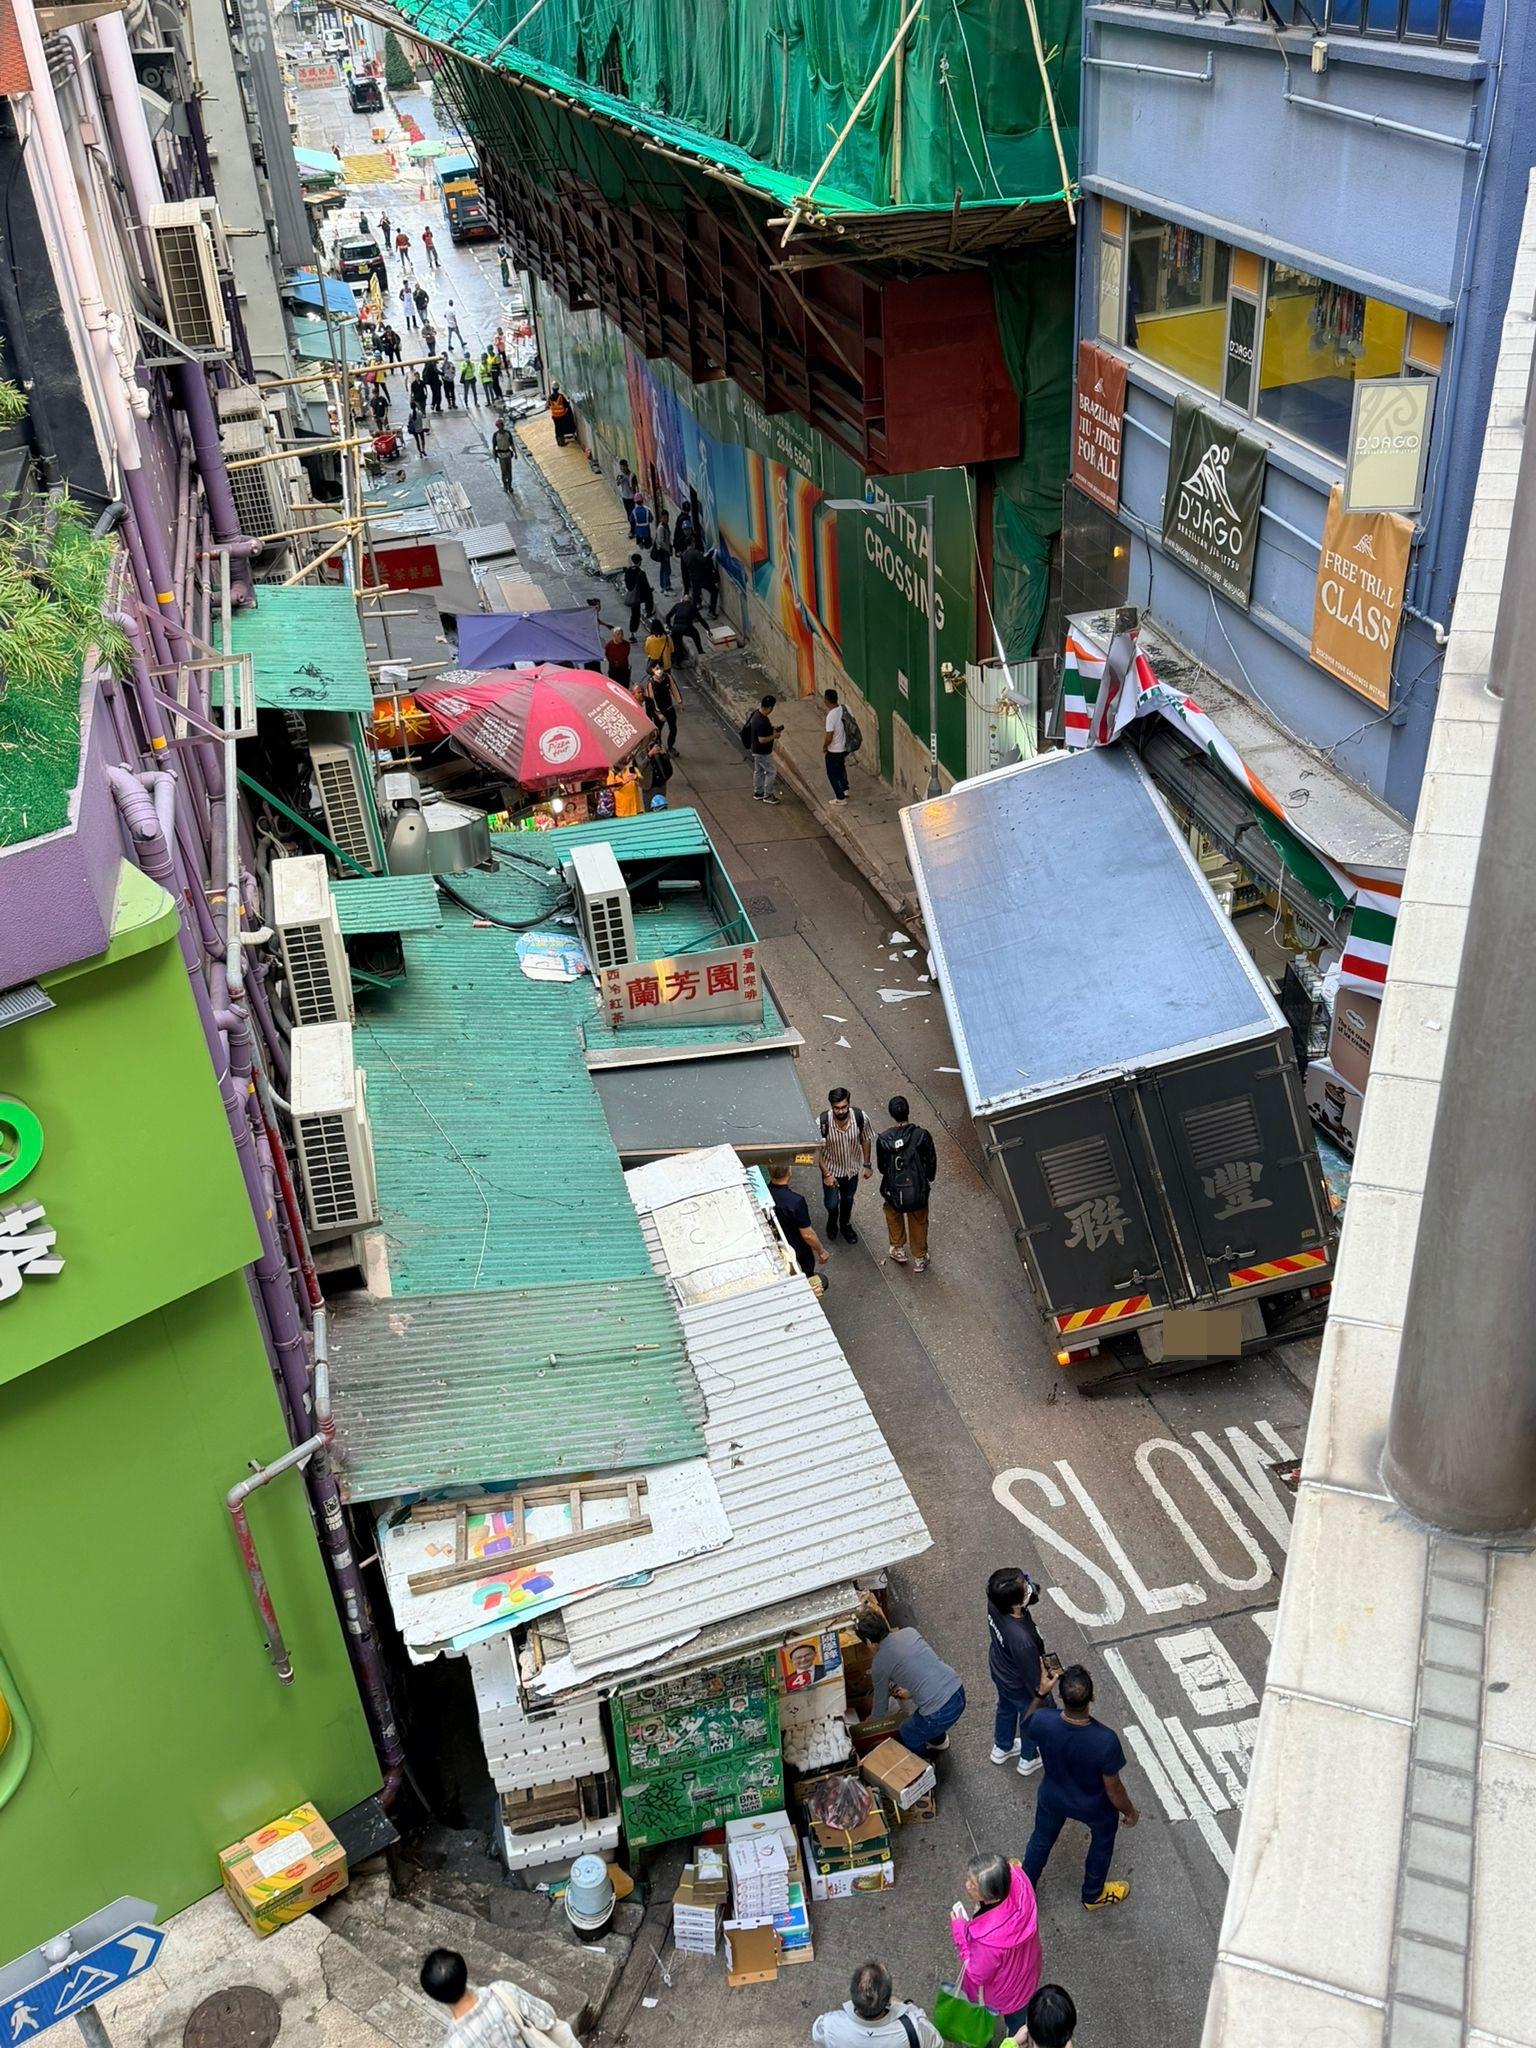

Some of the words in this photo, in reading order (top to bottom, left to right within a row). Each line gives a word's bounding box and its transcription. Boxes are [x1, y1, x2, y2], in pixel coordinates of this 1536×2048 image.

[1079, 393, 1121, 433] BRAZILIAN
[1077, 436, 1097, 469] FOR
[1096, 454, 1118, 481] ALL
[1356, 435, 1420, 450] D'JAGO
[1177, 490, 1243, 556] D'JAGO
[1177, 522, 1209, 551] BRAZILIAN
[865, 526, 945, 631] CROSSING
[1324, 549, 1357, 584] FREE
[1360, 565, 1396, 609] TRIAL
[1320, 579, 1391, 652] CLASS
[548, 740, 571, 754] Pizza
[606, 968, 625, 1024] 西冷紅茶
[625, 961, 739, 1010] 蘭芳園
[1337, 1025, 1344, 1034] of
[1343, 1029, 1351, 1040] ice
[1351, 1037, 1370, 1056] creams
[1338, 1016, 1347, 1029] The
[1347, 1025, 1356, 1036] ice
[1355, 1033, 1371, 1050] cream
[991, 1419, 1303, 1627] SLOW
[791, 1673, 806, 1687] 4
[710, 1736, 731, 1747] PAY
